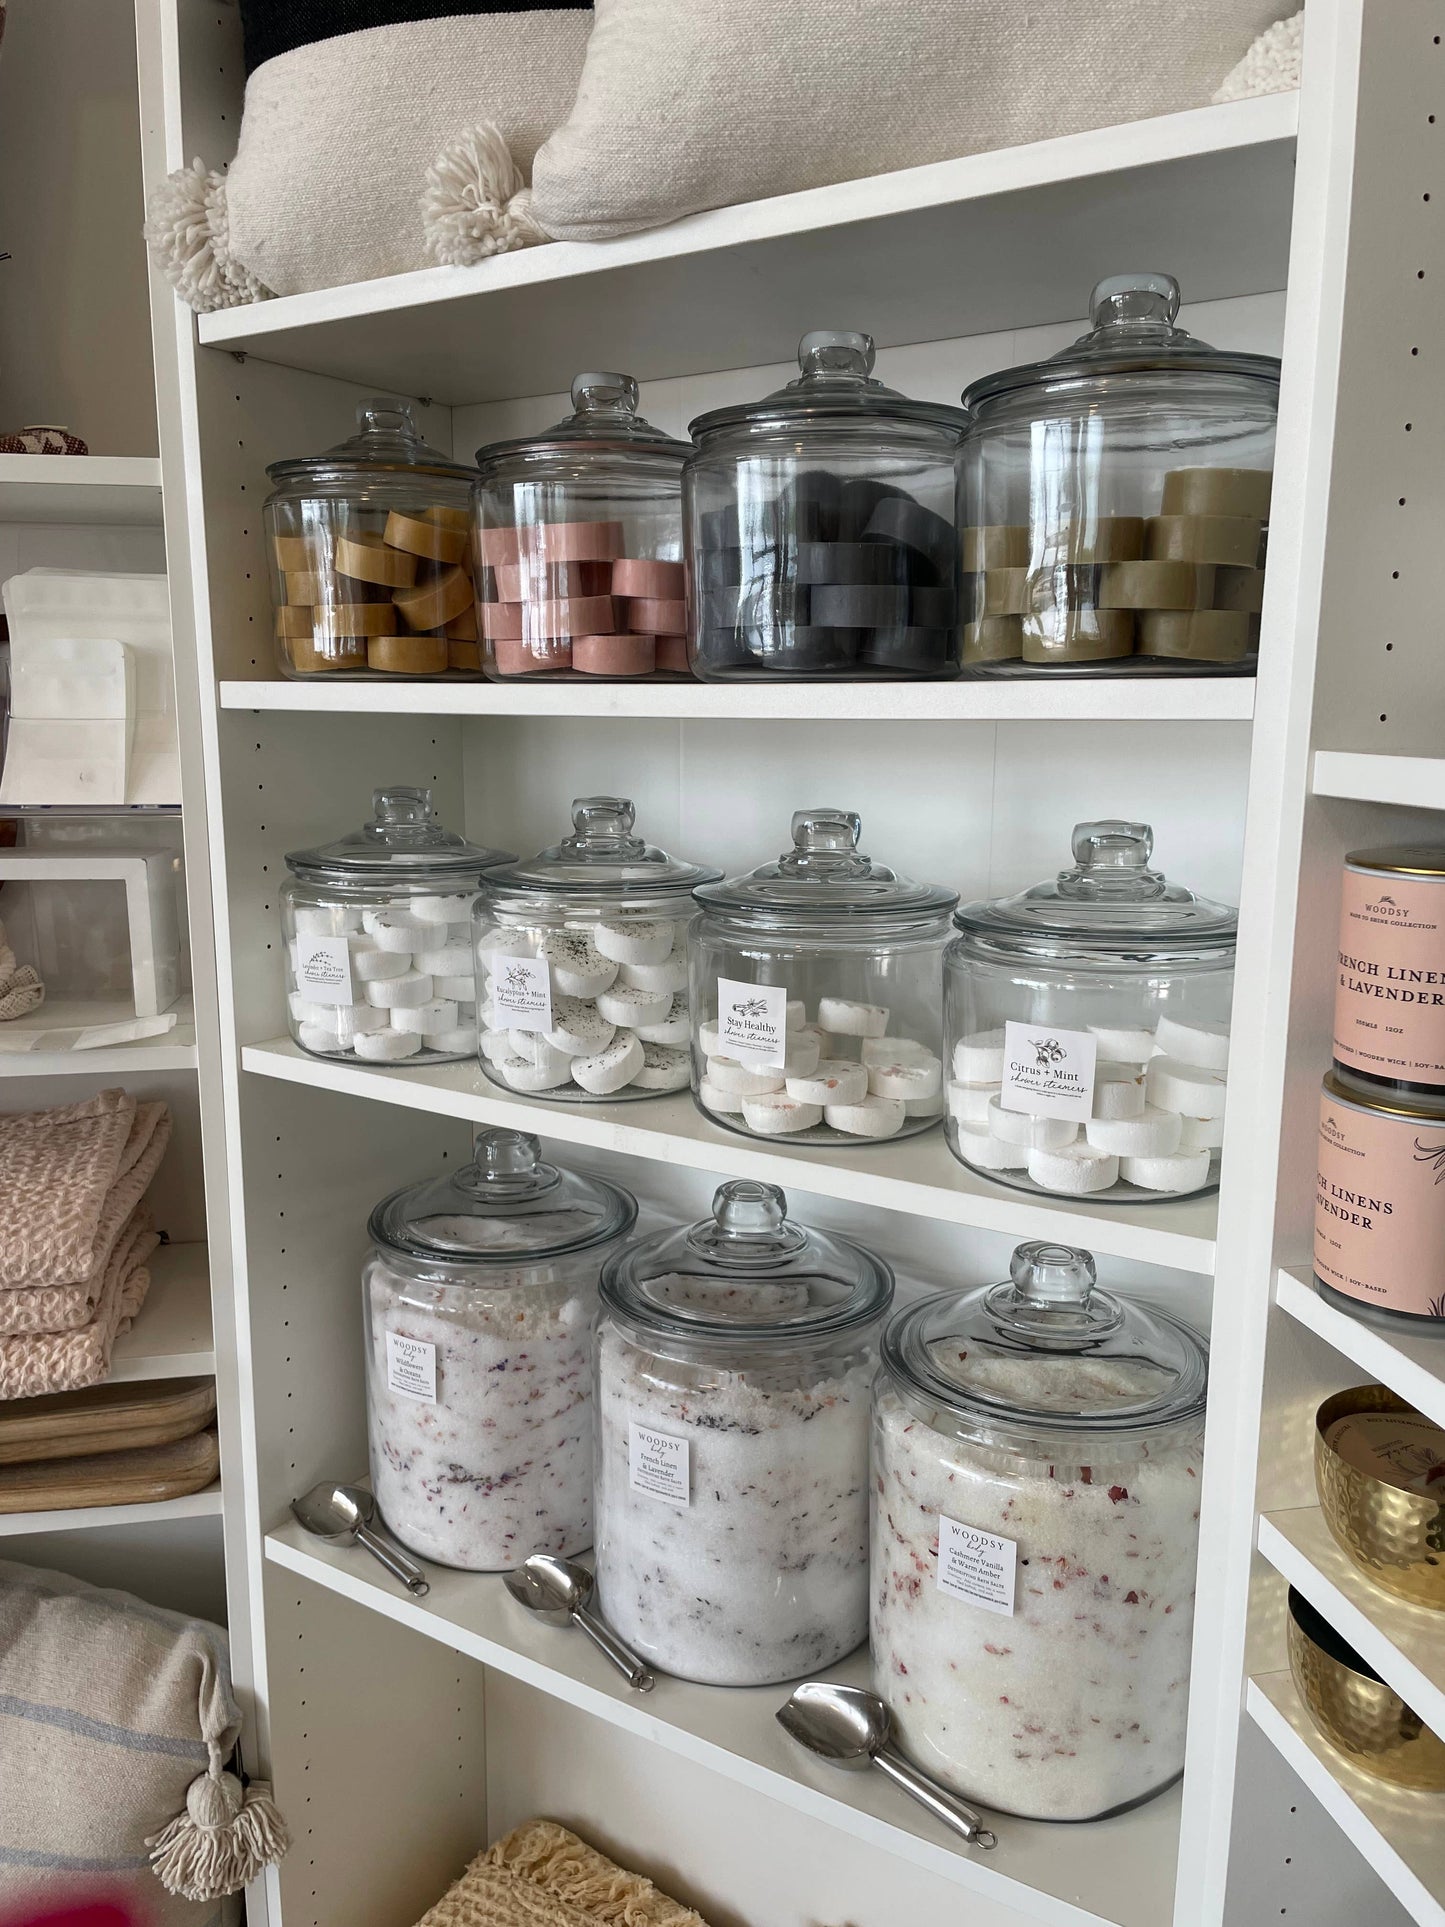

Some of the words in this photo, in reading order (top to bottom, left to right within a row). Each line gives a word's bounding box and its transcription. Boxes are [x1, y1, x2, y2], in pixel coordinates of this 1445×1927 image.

[1365, 904, 1409, 917] WOODSY
[1390, 920, 1437, 930] COLLECTION
[1338, 950, 1379, 976] RENCH
[1348, 978, 1445, 1006] LAVENDER
[727, 1016, 743, 1029] Stay
[744, 1020, 777, 1035] Healthy
[1010, 1061, 1041, 1076] Citrus
[1053, 1069, 1079, 1082] Mint
[1387, 1058, 1407, 1066] WICK
[1414, 1062, 1445, 1070] SOY-BA
[1010, 1072, 1041, 1086] shower
[1043, 1080, 1088, 1094] steamers
[1333, 1141, 1366, 1157] COLLECTION
[1331, 1184, 1393, 1214] LINENS
[1349, 1278, 1387, 1294] SOY-BASED
[393, 1338, 427, 1355] WOODSY
[638, 1431, 680, 1451] WOODSY
[640, 1453, 660, 1465] French
[648, 1465, 675, 1478] Lavender
[951, 1526, 1005, 1551] WOODSY
[949, 1547, 980, 1563] Cashmere
[980, 1558, 1004, 1572] Vanilla
[951, 1557, 958, 1565] &
[957, 1559, 978, 1572] Warm
[978, 1567, 1001, 1580] Amber
